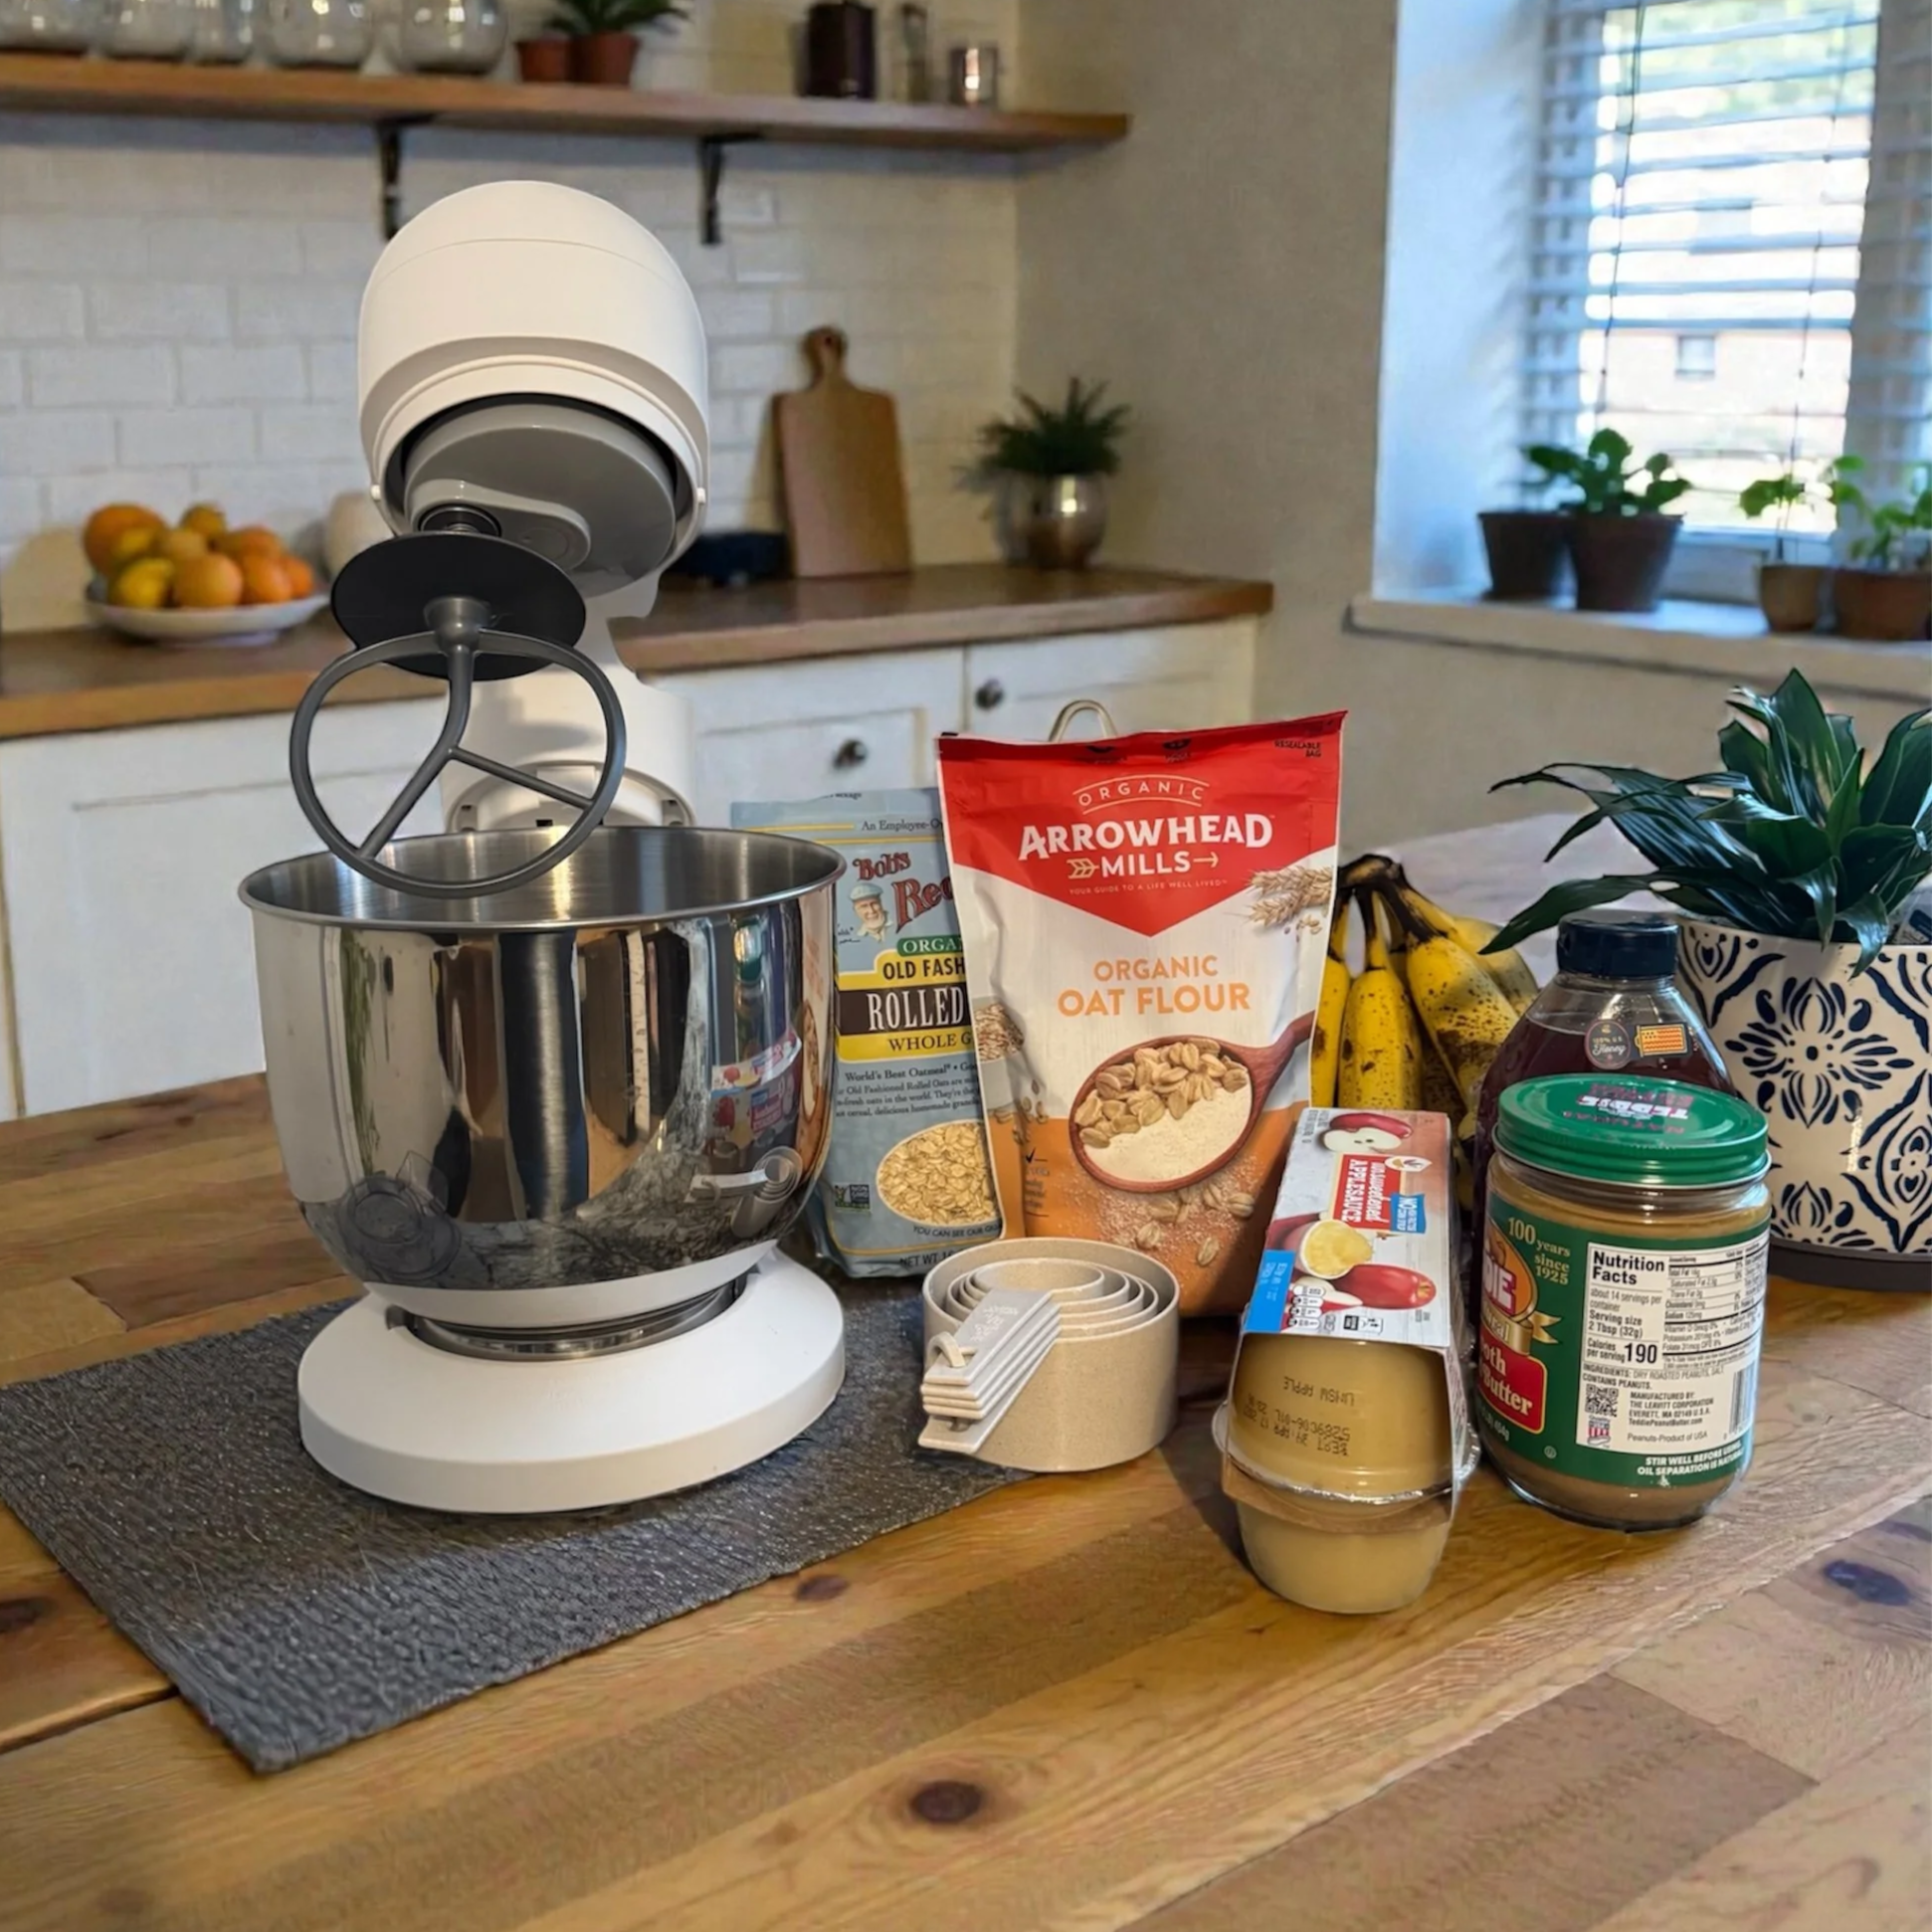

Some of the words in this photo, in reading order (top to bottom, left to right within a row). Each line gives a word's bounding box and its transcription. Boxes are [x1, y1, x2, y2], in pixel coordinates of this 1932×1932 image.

[1274, 740, 1321, 749] RESEALABLE
[1305, 749, 1321, 758] BAG
[1078, 781, 1205, 807] ORGANIC
[862, 821, 875, 831] An
[1018, 814, 1273, 862] ARROWHEAD
[853, 853, 911, 881] Bob's
[1101, 851, 1192, 877] MILLS
[1094, 885, 1119, 894] GUIDE
[883, 961, 916, 980] OLD
[1094, 955, 1219, 983] ORGANIC
[866, 986, 964, 1031] ROLLED
[1058, 988, 1125, 1018] OAT
[1136, 983, 1251, 1016] FLOUR
[888, 1034, 957, 1053] WHOLE
[845, 1070, 881, 1082] World's
[884, 1069, 906, 1079] Best
[847, 1086, 863, 1095] Old
[865, 1083, 904, 1093] Fashioned
[906, 1080, 930, 1090] Rolled
[932, 1079, 949, 1088] Oats
[894, 1094, 907, 1103] the
[908, 1091, 932, 1101] world.
[910, 1100, 951, 1112] homemade
[1341, 1159, 1368, 1223] APPLESAUCE
[913, 1226, 931, 1236] YOU
[967, 1228, 984, 1237] OUR
[1508, 1217, 1536, 1245] 100
[1536, 1240, 1571, 1256] years
[922, 1254, 937, 1264] WT
[1534, 1254, 1570, 1272] since
[1594, 1251, 1664, 1271] Nutrition
[1536, 1265, 1569, 1285] 1925
[1593, 1266, 1638, 1285] Facts
[1591, 1287, 1610, 1298] about
[1612, 1290, 1620, 1300] 14
[1621, 1292, 1649, 1305] servings
[1651, 1295, 1662, 1305] per
[1590, 1299, 1621, 1312] container
[1590, 1309, 1623, 1326] Serving
[1625, 1314, 1642, 1326] size
[1588, 1321, 1595, 1331] 2
[1597, 1322, 1618, 1336] Tbsp
[1620, 1325, 1642, 1339] (32g)
[1587, 1348, 1599, 1359] per
[1600, 1350, 1626, 1364] serving
[1588, 1337, 1617, 1351] Calories
[1625, 1343, 1658, 1364] 190
[1583, 1363, 1632, 1378] INGREDIENTS:
[1283, 1376, 1313, 1398] APPLE
[1582, 1373, 1617, 1387] CONTAINS
[1619, 1378, 1652, 1390] PEANUTS.
[1630, 1400, 1642, 1409] THE
[1644, 1400, 1670, 1410] LEAVITT
[1672, 1398, 1714, 1409] CORPORATION
[1629, 1410, 1660, 1420] EVERETT,
[1629, 1418, 1702, 1427] TeddiePeanutButter.com
[1628, 1433, 1684, 1442] Peanuts-Product
[1694, 1431, 1708, 1440] USA
[1645, 1456, 1667, 1466] STIR
[1668, 1455, 1692, 1465] WELL
[1693, 1449, 1722, 1463] BEFORE
[1637, 1466, 1653, 1475] OIL
[1655, 1462, 1710, 1475] SEPARATION
